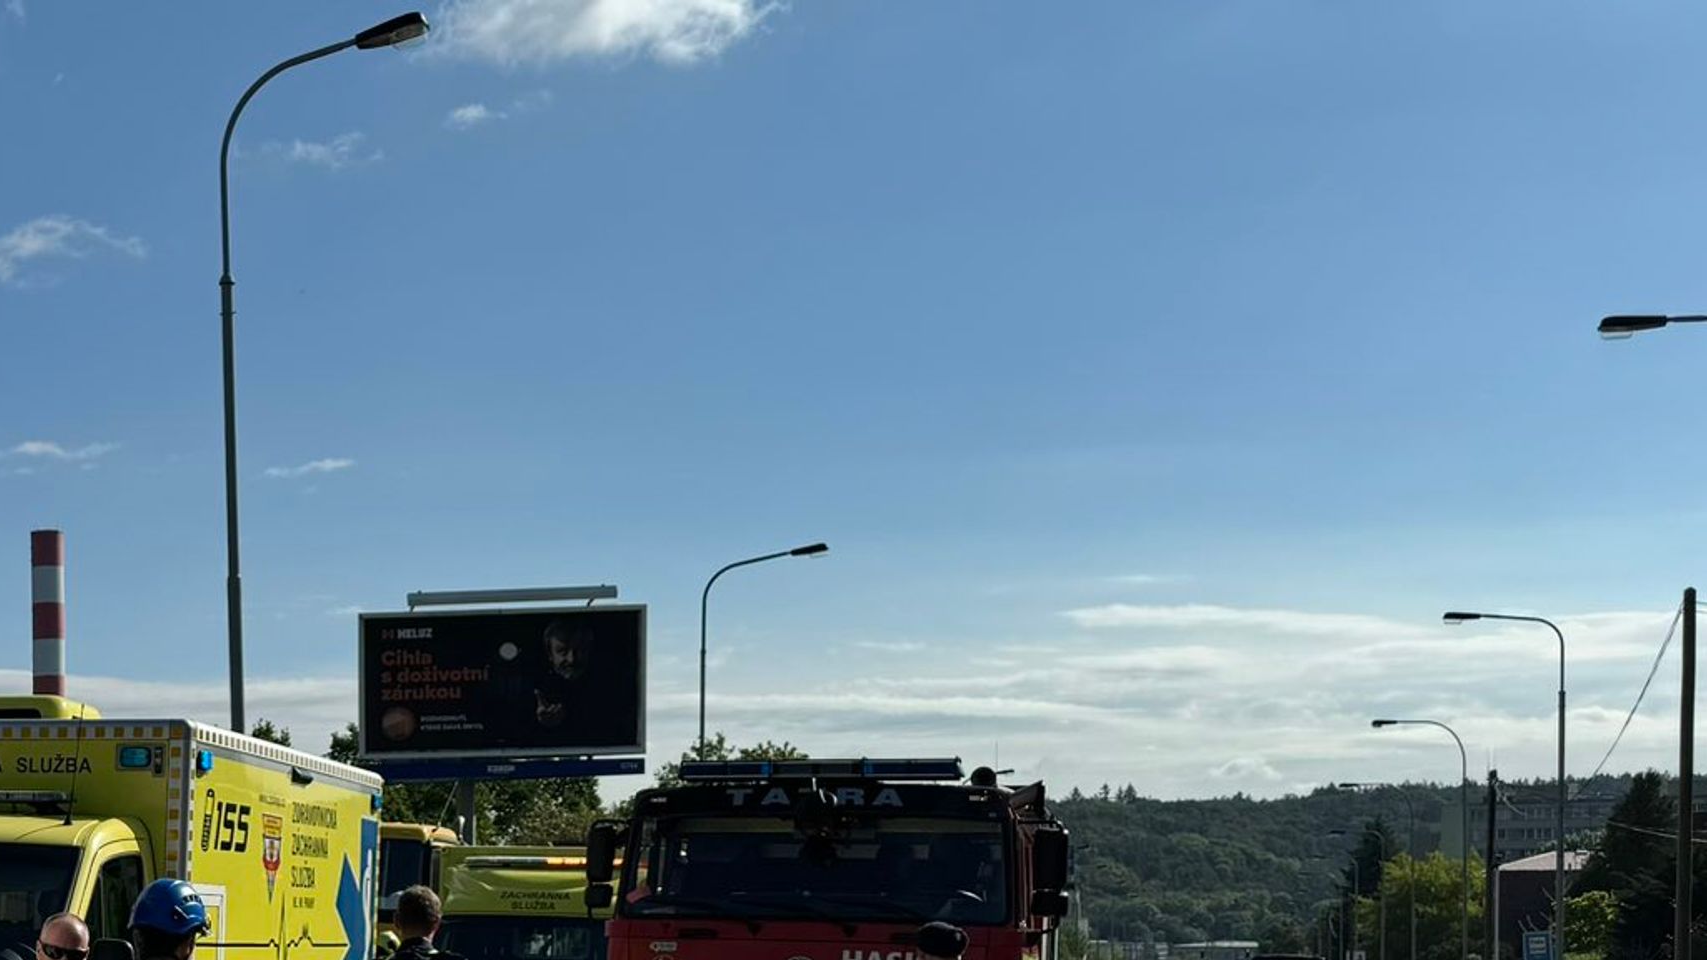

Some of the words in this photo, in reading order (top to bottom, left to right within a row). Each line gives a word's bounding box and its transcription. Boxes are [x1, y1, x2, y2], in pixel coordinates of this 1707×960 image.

[381, 649, 433, 666] Cihla
[381, 671, 392, 684] s
[397, 665, 489, 683] doživotní
[381, 683, 462, 701] zárukou
[16, 752, 92, 774] SLUŽBA
[726, 787, 904, 808] TARA
[213, 800, 252, 852] 155
